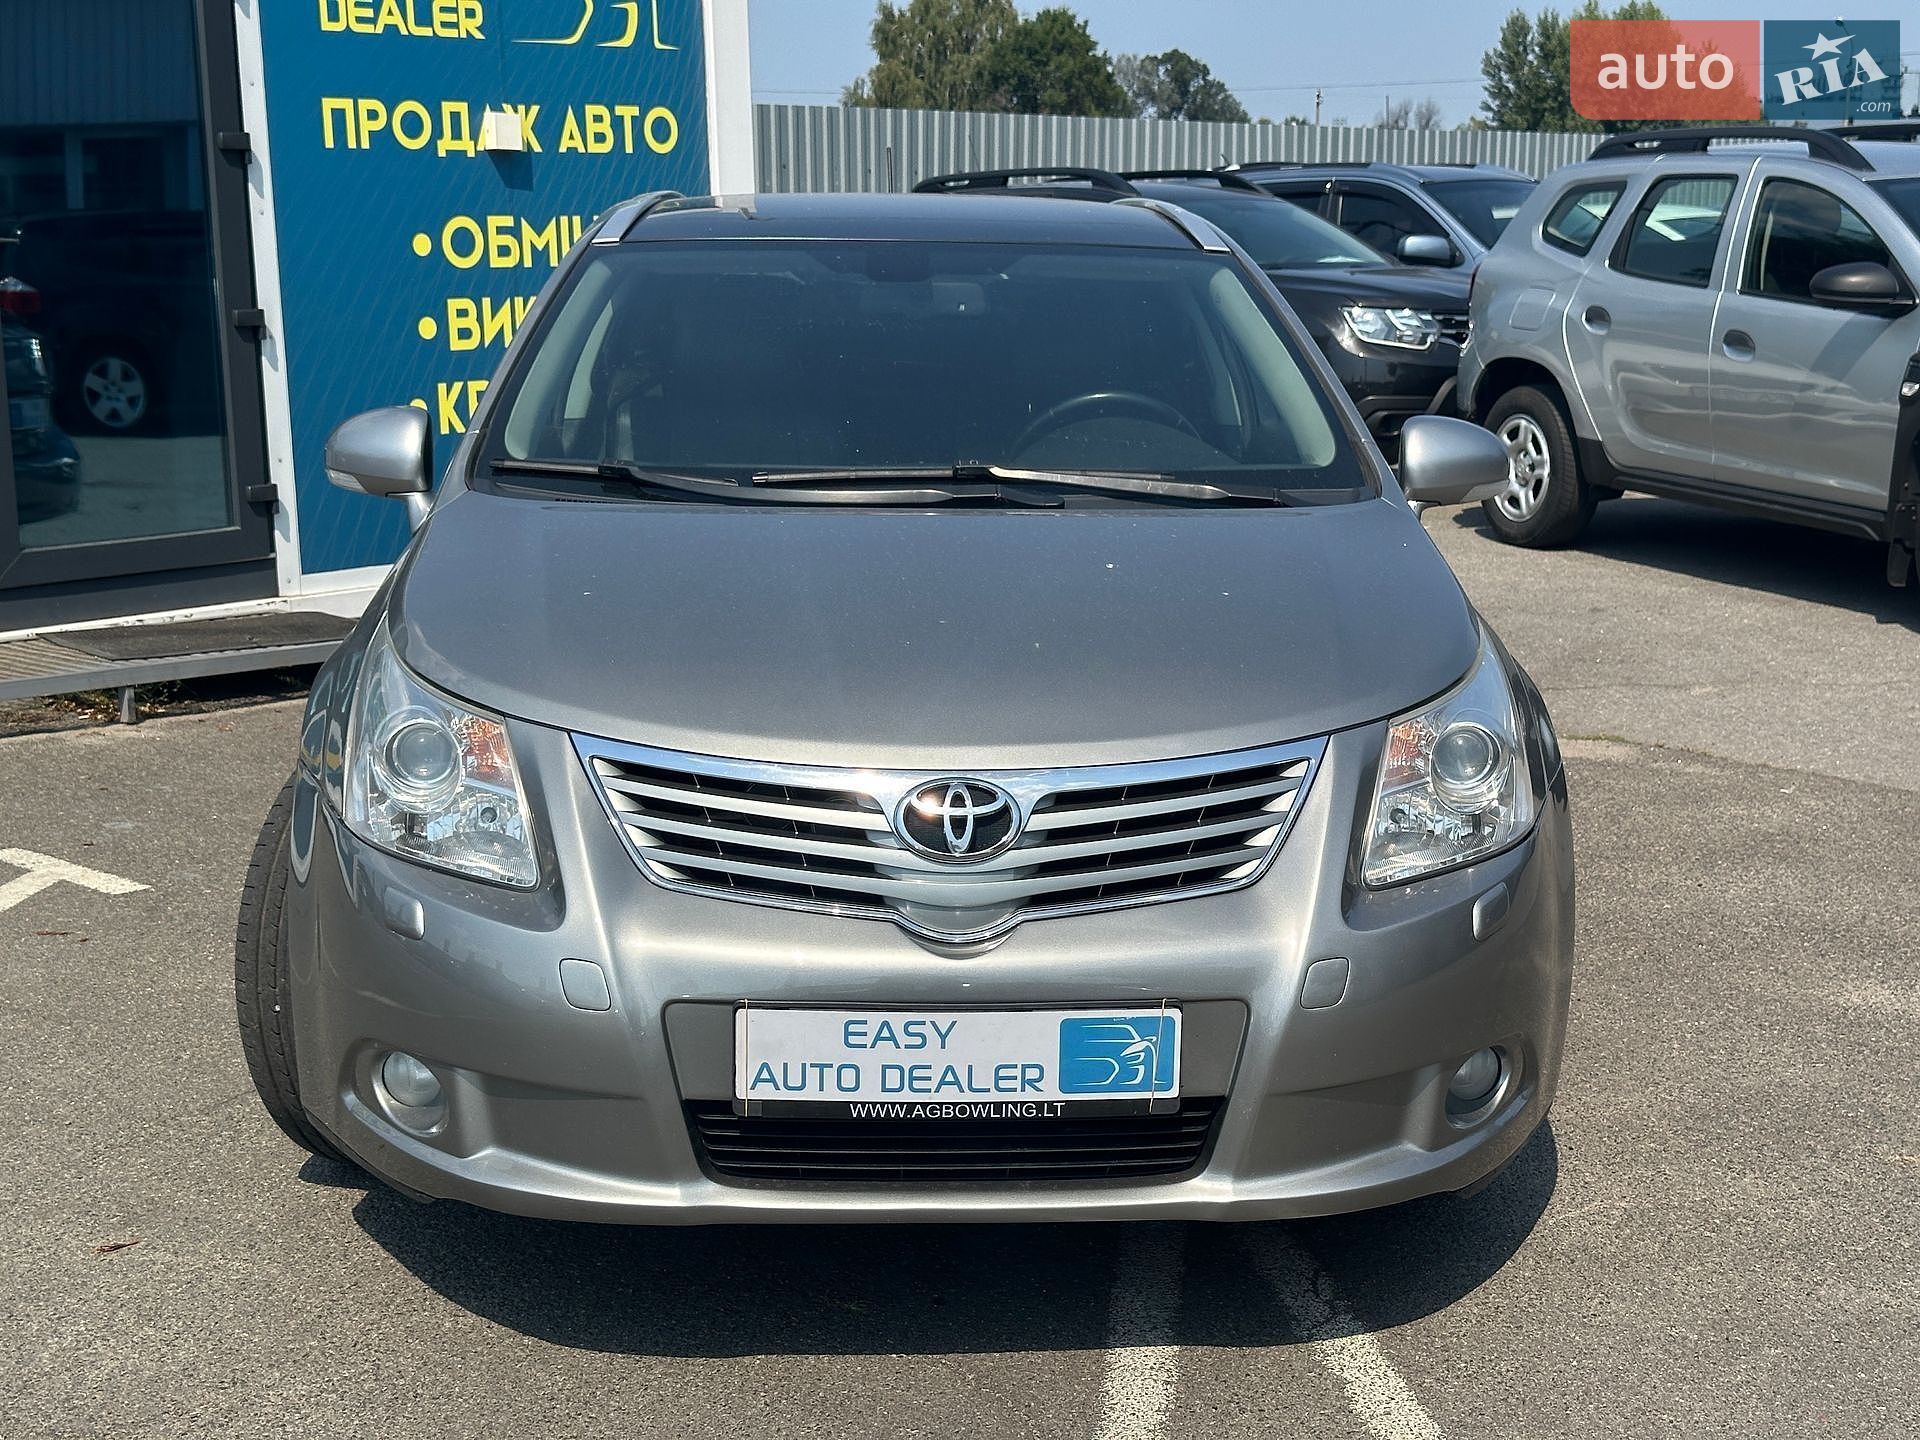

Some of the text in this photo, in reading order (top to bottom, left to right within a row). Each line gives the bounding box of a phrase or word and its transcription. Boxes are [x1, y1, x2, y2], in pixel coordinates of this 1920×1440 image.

[319, 0, 486, 40] DEALER
[558, 104, 680, 154] АВТО
[842, 1019, 959, 1050] EASY
[749, 1062, 1045, 1094] AUTO DEALER
[848, 1102, 1067, 1120] WWW.AGBOWLING.LT
